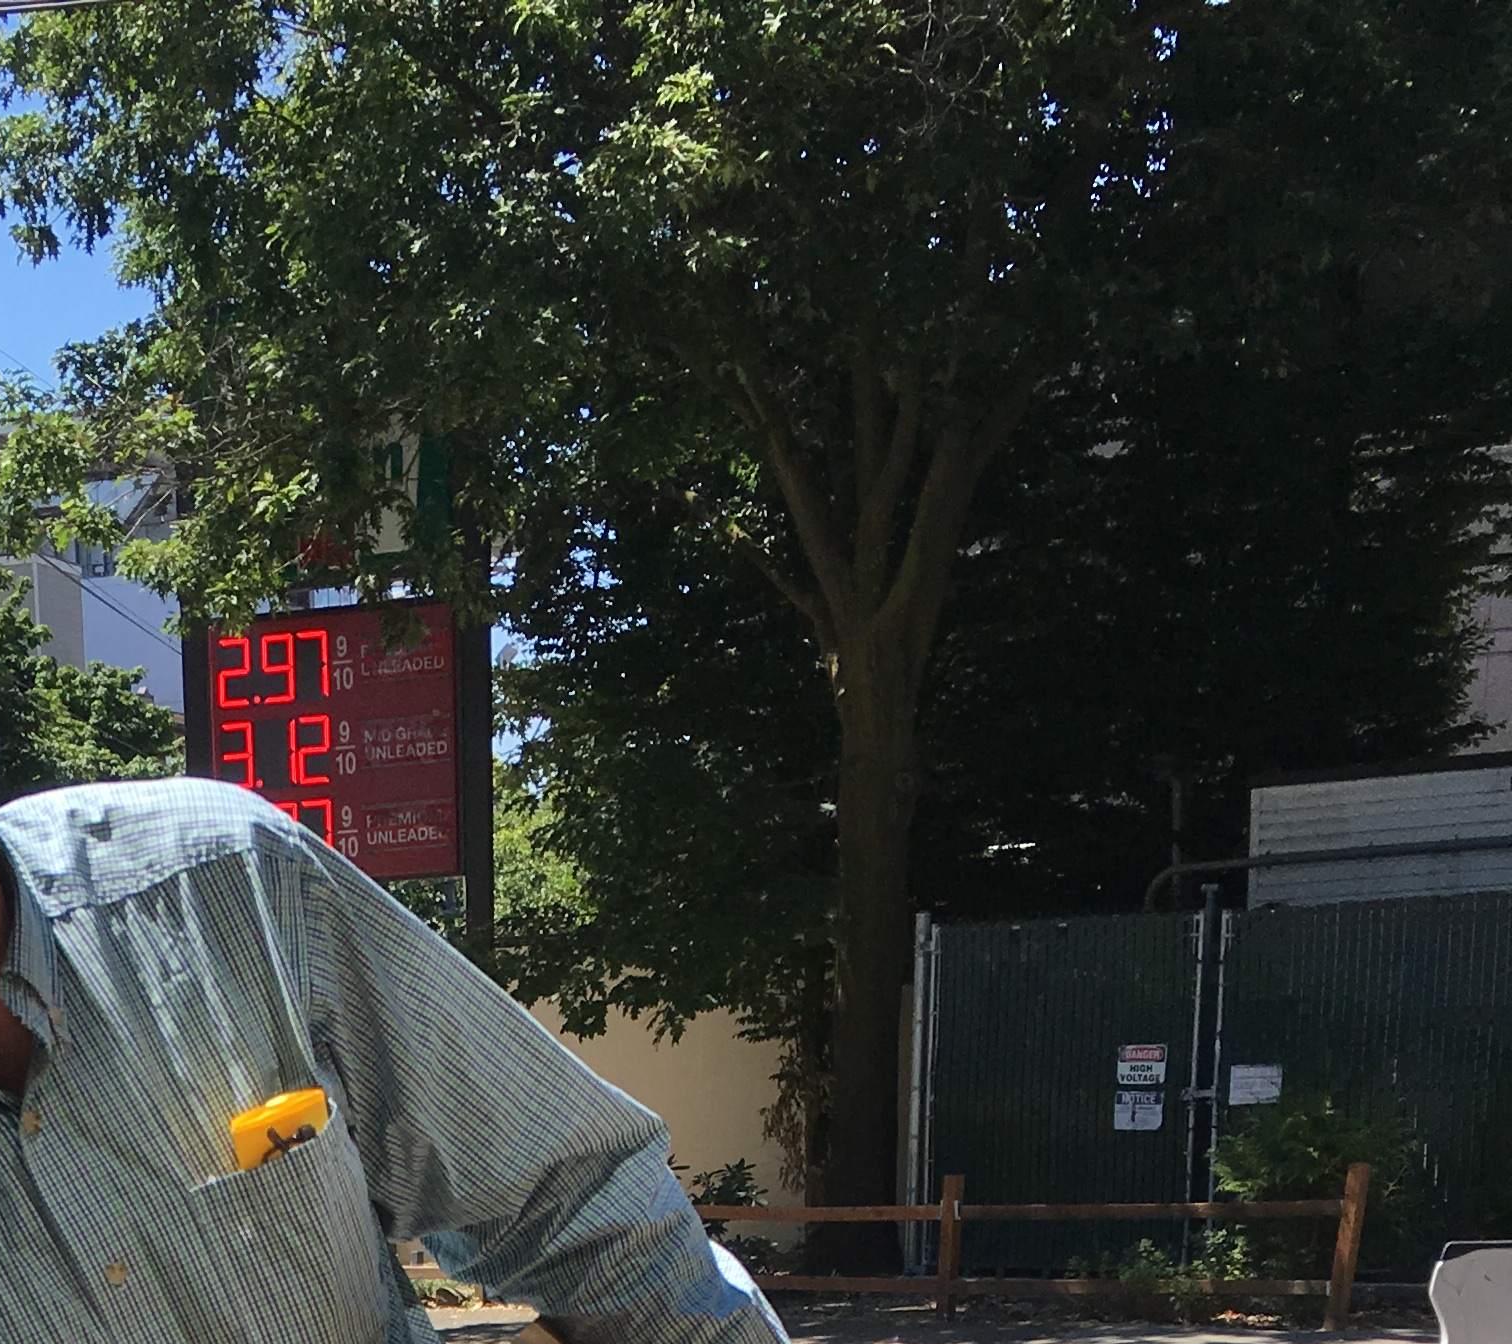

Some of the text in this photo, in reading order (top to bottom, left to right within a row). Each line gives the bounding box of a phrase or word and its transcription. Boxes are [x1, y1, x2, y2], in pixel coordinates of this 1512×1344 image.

[336, 635, 347, 657] 9
[217, 630, 331, 709] 2.97
[361, 654, 445, 676] ULEADED
[334, 667, 353, 690] 10
[339, 720, 350, 743] 9
[221, 714, 331, 789] 3.12
[336, 752, 356, 775] 10
[341, 805, 352, 828] 9
[339, 836, 359, 858] 10
[1125, 1049, 1161, 1060] DANGER
[1120, 1073, 1161, 1083] VOLTAGE
[1129, 1064, 1153, 1073] HIGH
[1121, 1093, 1157, 1105] NOTICE
